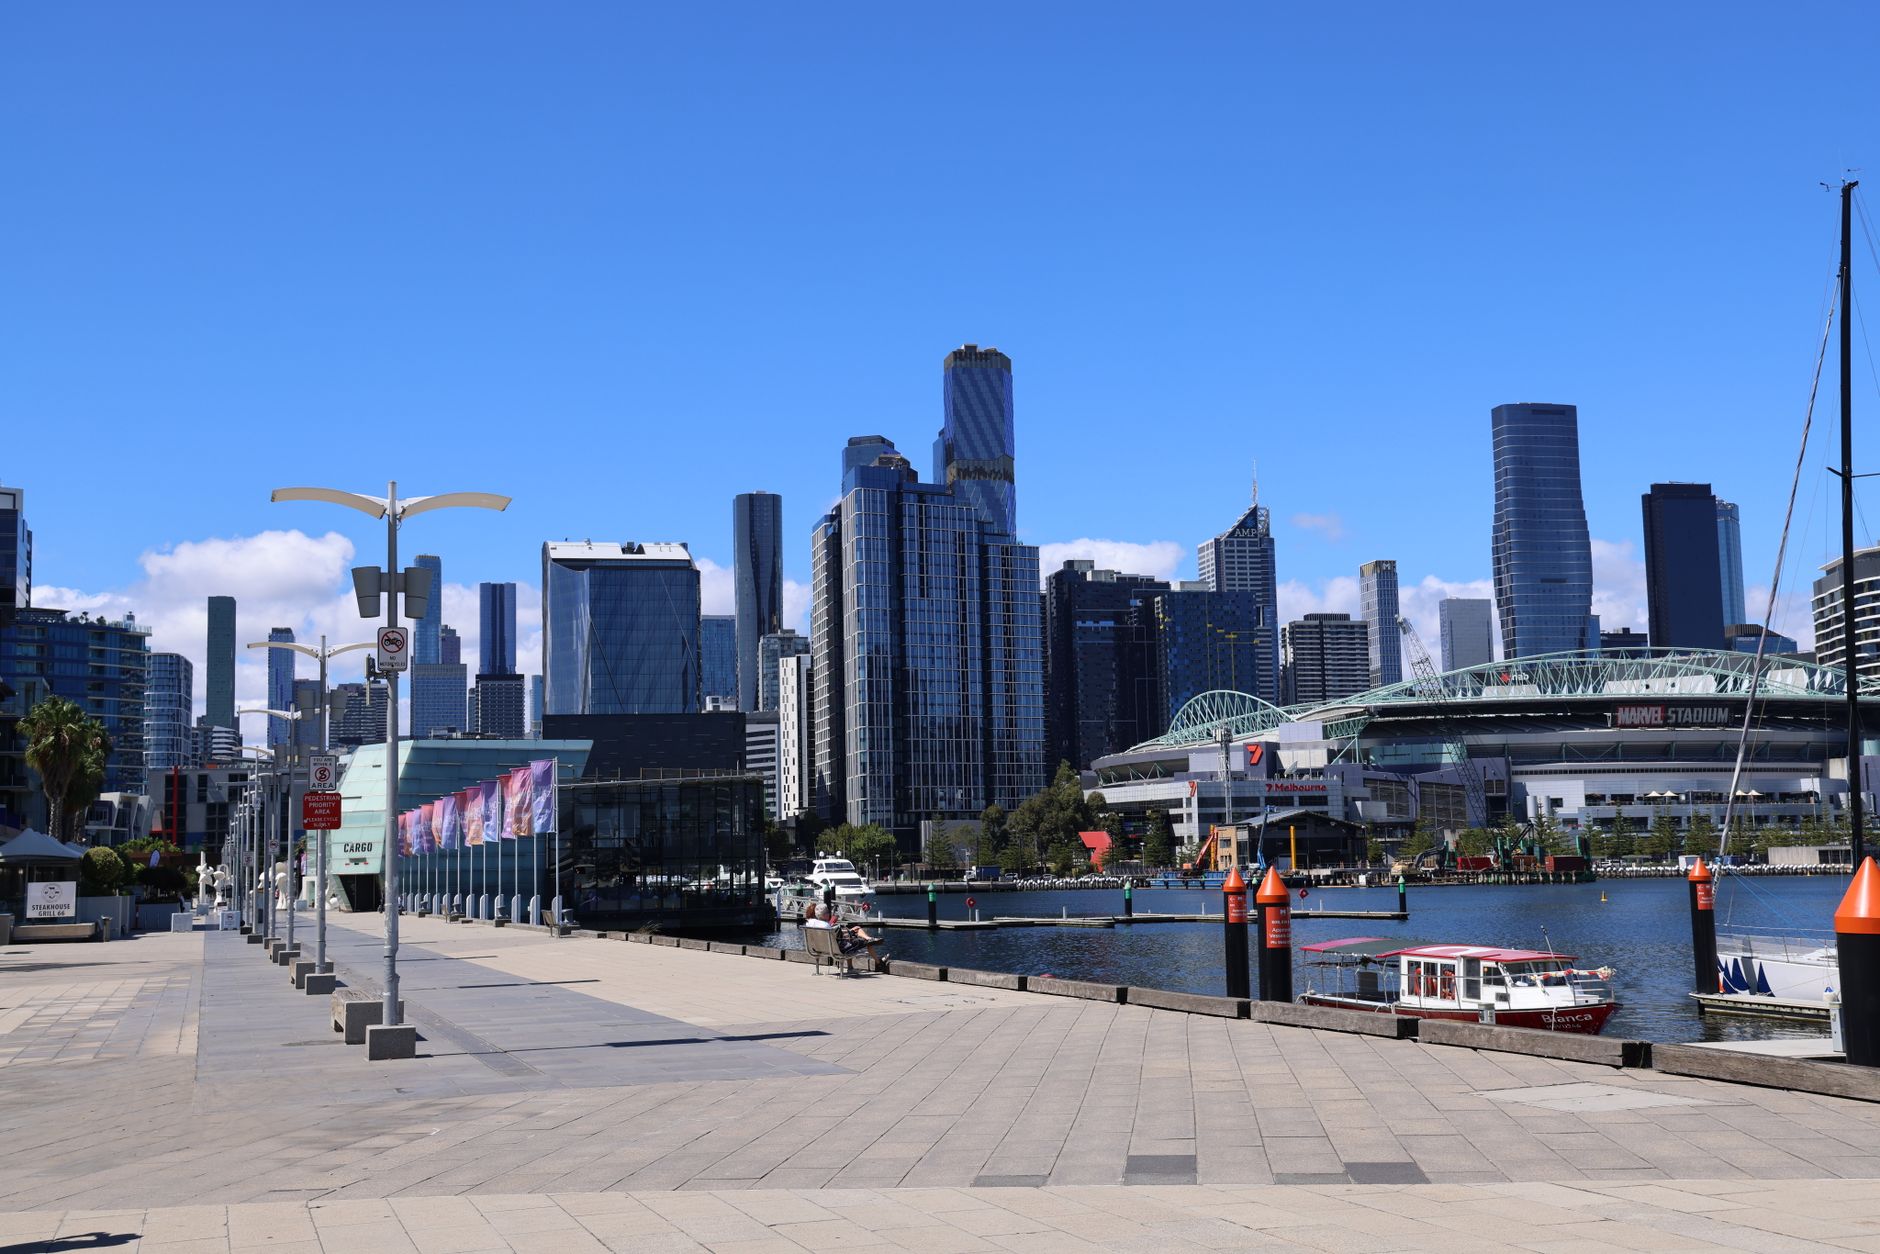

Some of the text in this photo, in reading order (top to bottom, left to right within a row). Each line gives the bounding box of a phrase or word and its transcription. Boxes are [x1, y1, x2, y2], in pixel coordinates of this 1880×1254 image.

[1235, 529, 1257, 537] AMP
[1512, 673, 1529, 681] nab
[1618, 706, 1729, 725] MARVEL STADIUM
[1275, 783, 1327, 792] Melbourne
[344, 842, 373, 853] CARGO
[32, 903, 71, 911] STEAKHOUSE
